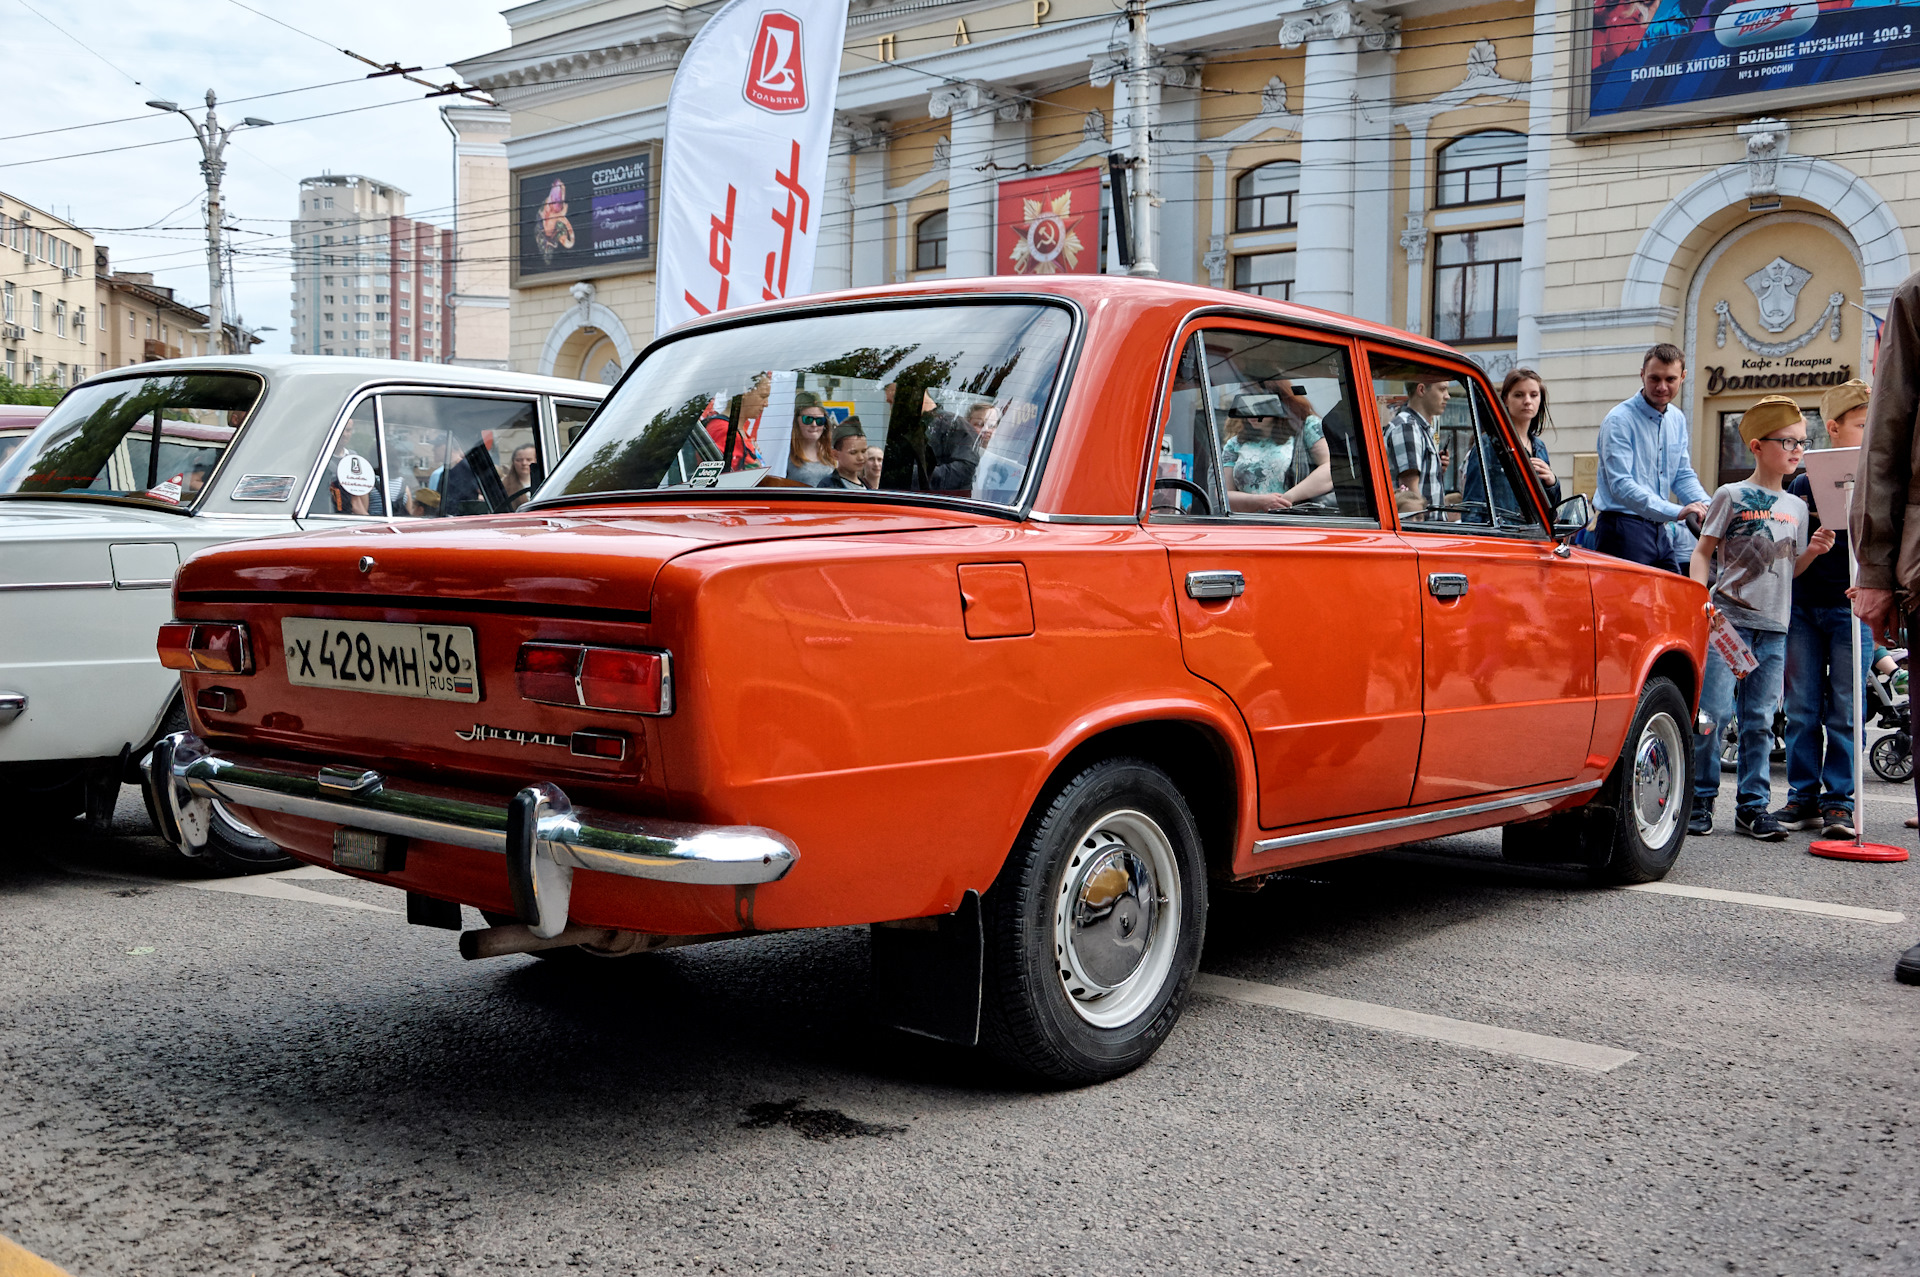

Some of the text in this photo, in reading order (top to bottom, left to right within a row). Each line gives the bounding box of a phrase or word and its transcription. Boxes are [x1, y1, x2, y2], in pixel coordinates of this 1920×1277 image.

[1631, 24, 1912, 83] БОЛЬШЕ ХИТОВ! БОЛЬШЕ МУЗЫКИ! 100.3
[1761, 63, 1794, 76] РОССИИ
[752, 89, 799, 104] ТОЛЬЯТТИ
[1742, 357, 1832, 371] Кафе Пекарня
[1704, 364, 1851, 395] Волконский
[698, 468, 717, 477] Jeep
[1741, 510, 1771, 521] MIAMI
[426, 632, 460, 675] 36
[429, 675, 454, 692] RUS
